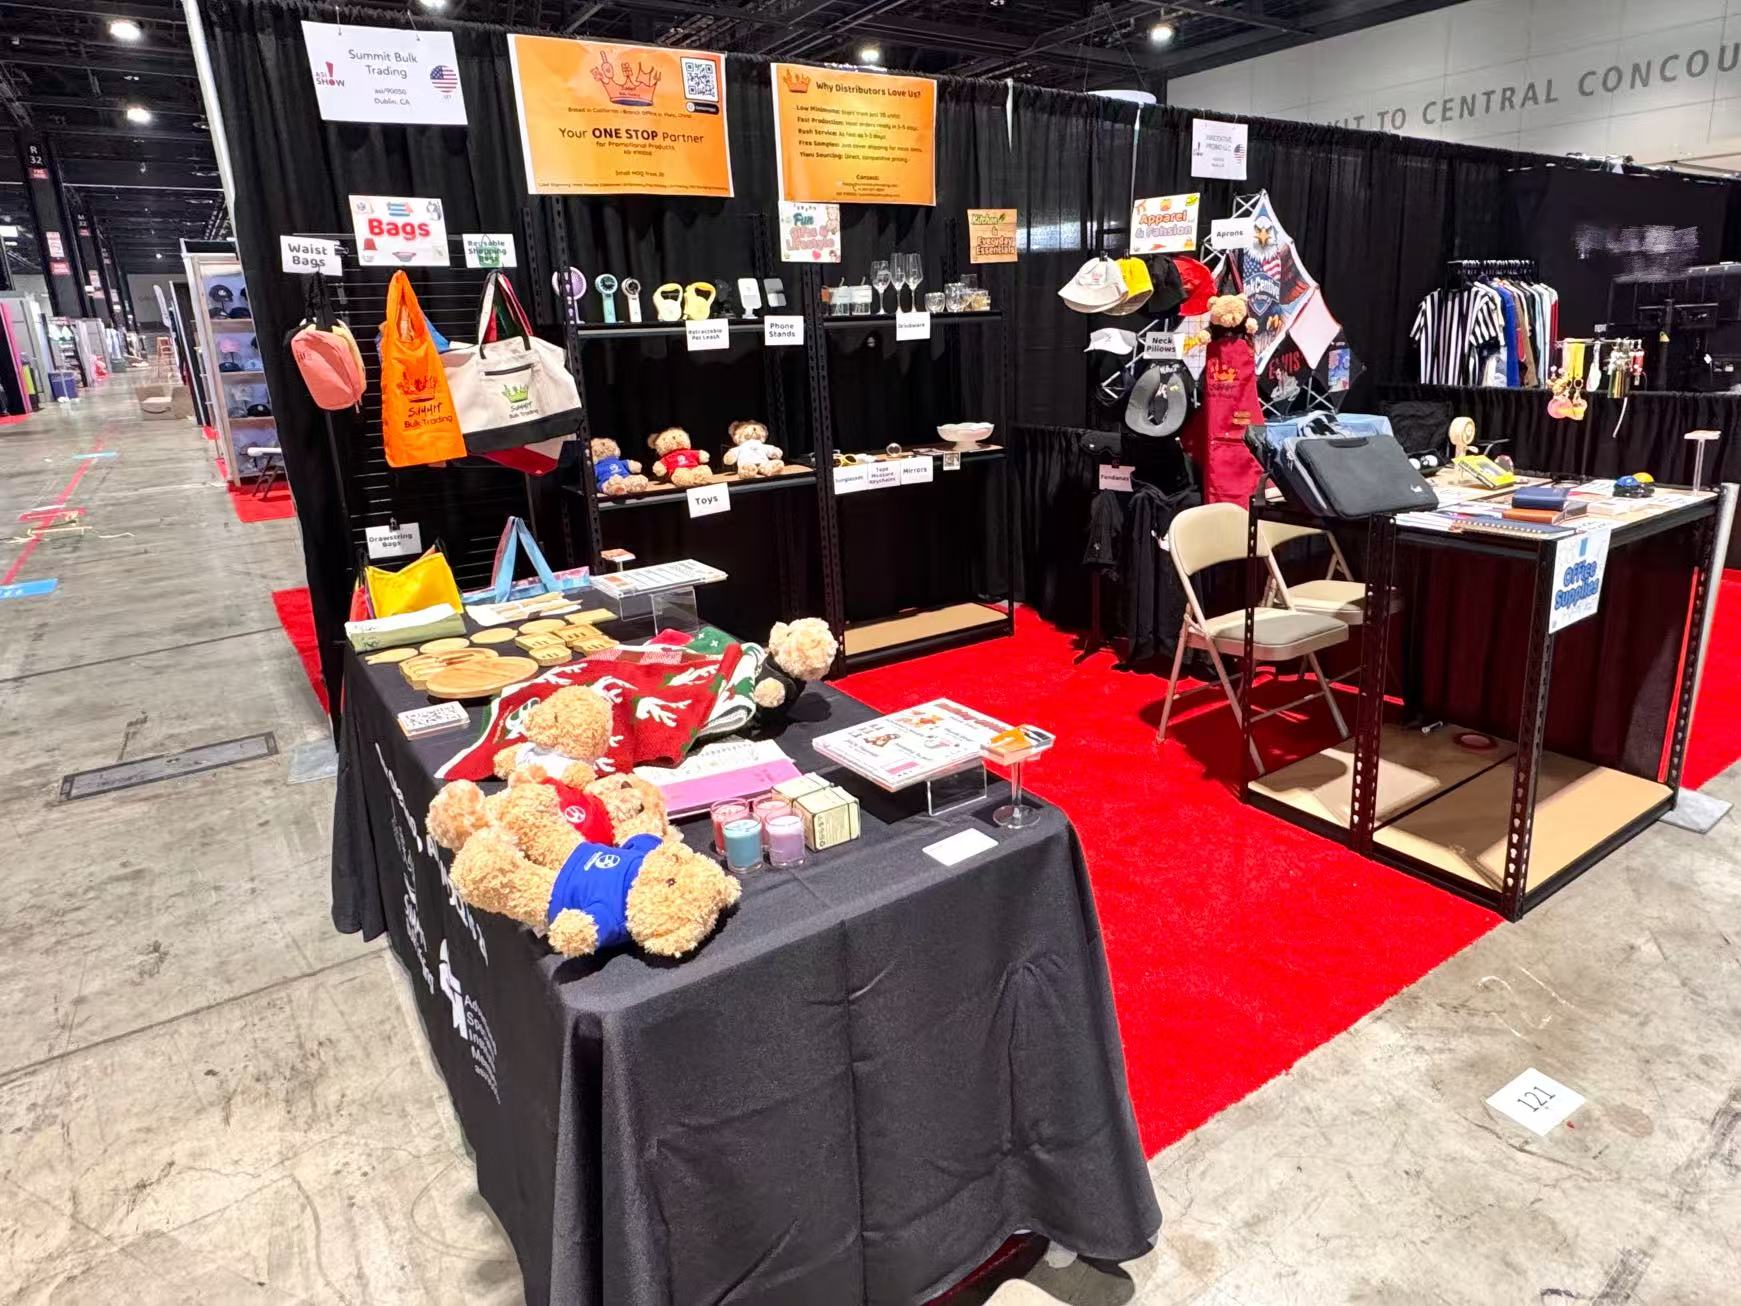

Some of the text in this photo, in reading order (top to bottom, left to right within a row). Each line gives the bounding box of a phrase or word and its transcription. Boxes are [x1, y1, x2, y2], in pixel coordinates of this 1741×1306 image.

[348, 49, 418, 63] Summit Bulk
[365, 64, 408, 79] Trading
[816, 81, 922, 99] Why Distributors Love Us?
[1376, 107, 1407, 130] TO
[1422, 78, 1560, 125] CENTRAL
[1577, 42, 1741, 97] CONCOU
[399, 98, 411, 106] CA
[559, 127, 704, 143] Your ONE STOP Partner
[29, 146, 38, 154] R
[607, 141, 647, 149] Promotional
[648, 143, 676, 151] Products
[30, 156, 42, 164] 32
[971, 213, 999, 226] Kitchen
[1139, 210, 1187, 226] Apparel
[368, 217, 431, 241] Bags
[1216, 230, 1244, 238] Aprons
[976, 234, 1014, 247] Everyday
[288, 242, 328, 256] Waist
[976, 245, 1016, 256] Essentials
[292, 254, 326, 268] Bags
[769, 322, 794, 330] Phone
[1152, 337, 1173, 345] Neck
[1147, 344, 1176, 353] Pillows
[520, 408, 540, 417] Trading
[404, 415, 453, 429] Bulk Trading
[903, 467, 928, 475] Mirrors
[694, 495, 719, 506] Toys
[369, 533, 413, 543] Drawstring
[382, 541, 402, 549] Bags
[1517, 1086, 1556, 1112] 121
